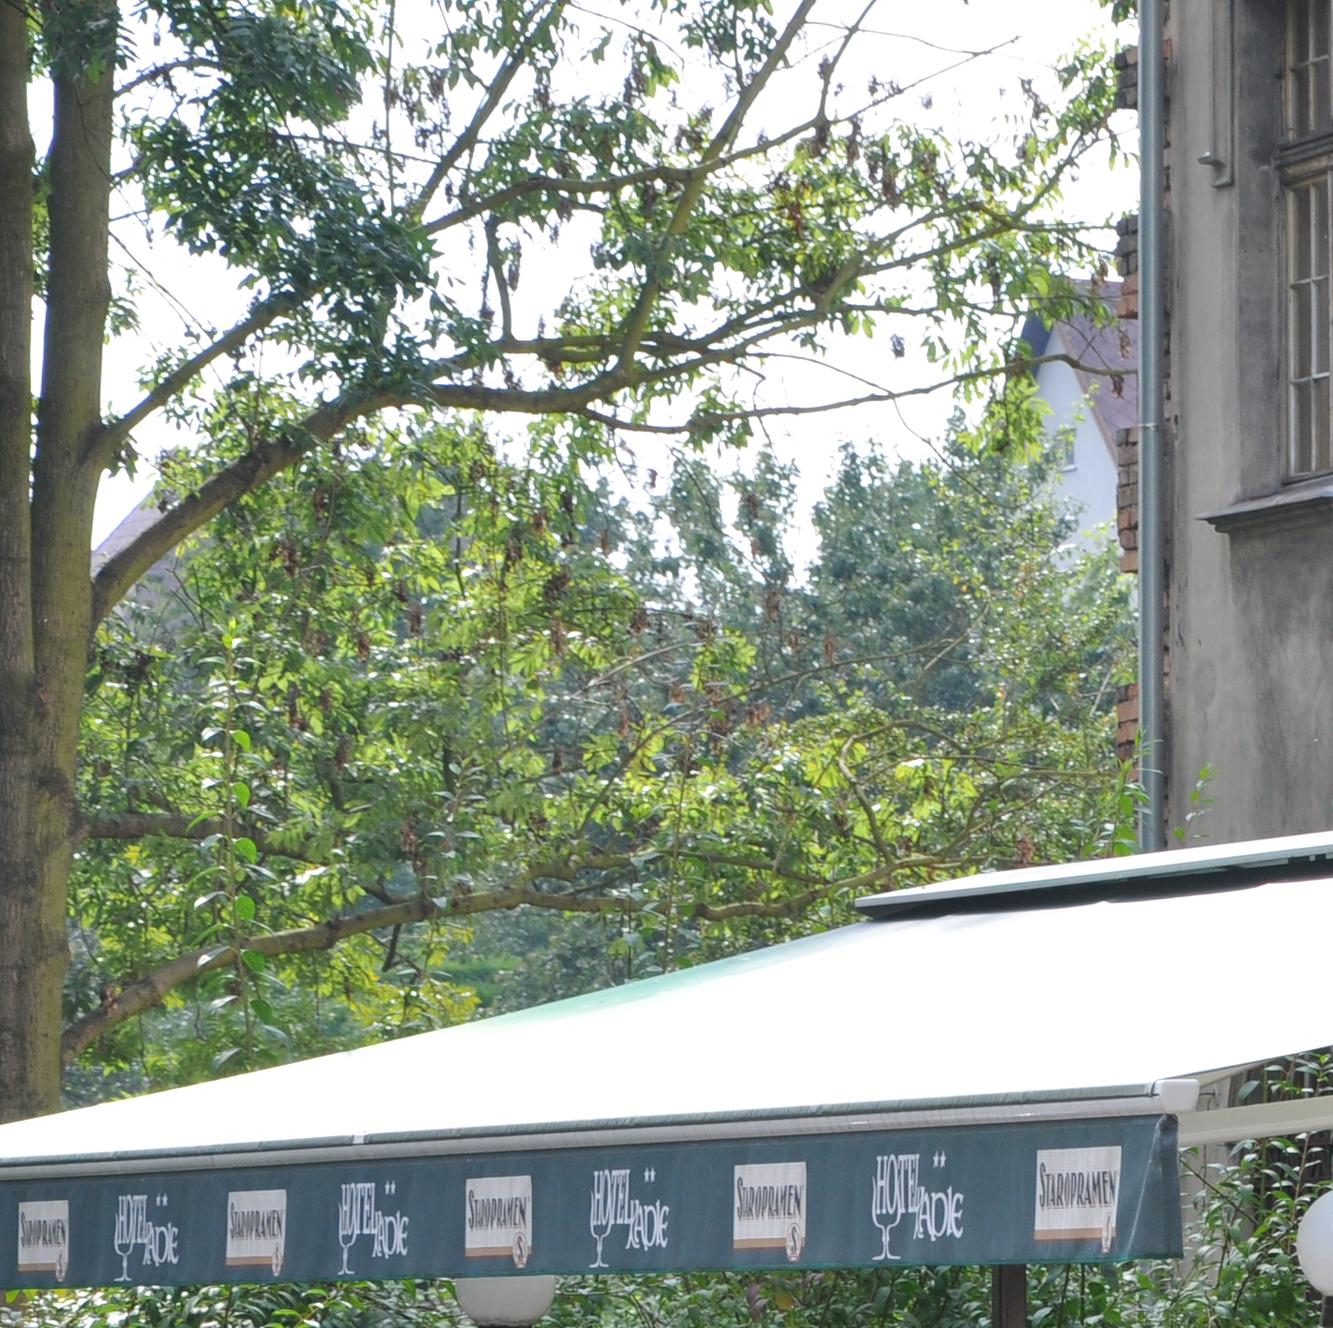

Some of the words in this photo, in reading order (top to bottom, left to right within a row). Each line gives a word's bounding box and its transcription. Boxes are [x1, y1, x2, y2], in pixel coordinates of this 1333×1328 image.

[593, 1169, 631, 1226] HOTEL
[737, 1176, 802, 1221] STAROPRAMEN
[876, 1153, 920, 1215] HOTEL
[1039, 1162, 1116, 1208] STAROPRAMEN
[119, 1195, 147, 1244] HOTEL
[230, 1202, 282, 1240] STAROPRAMEN
[341, 1182, 375, 1235] HOTEL
[468, 1189, 528, 1231] STAROPRAMEN
